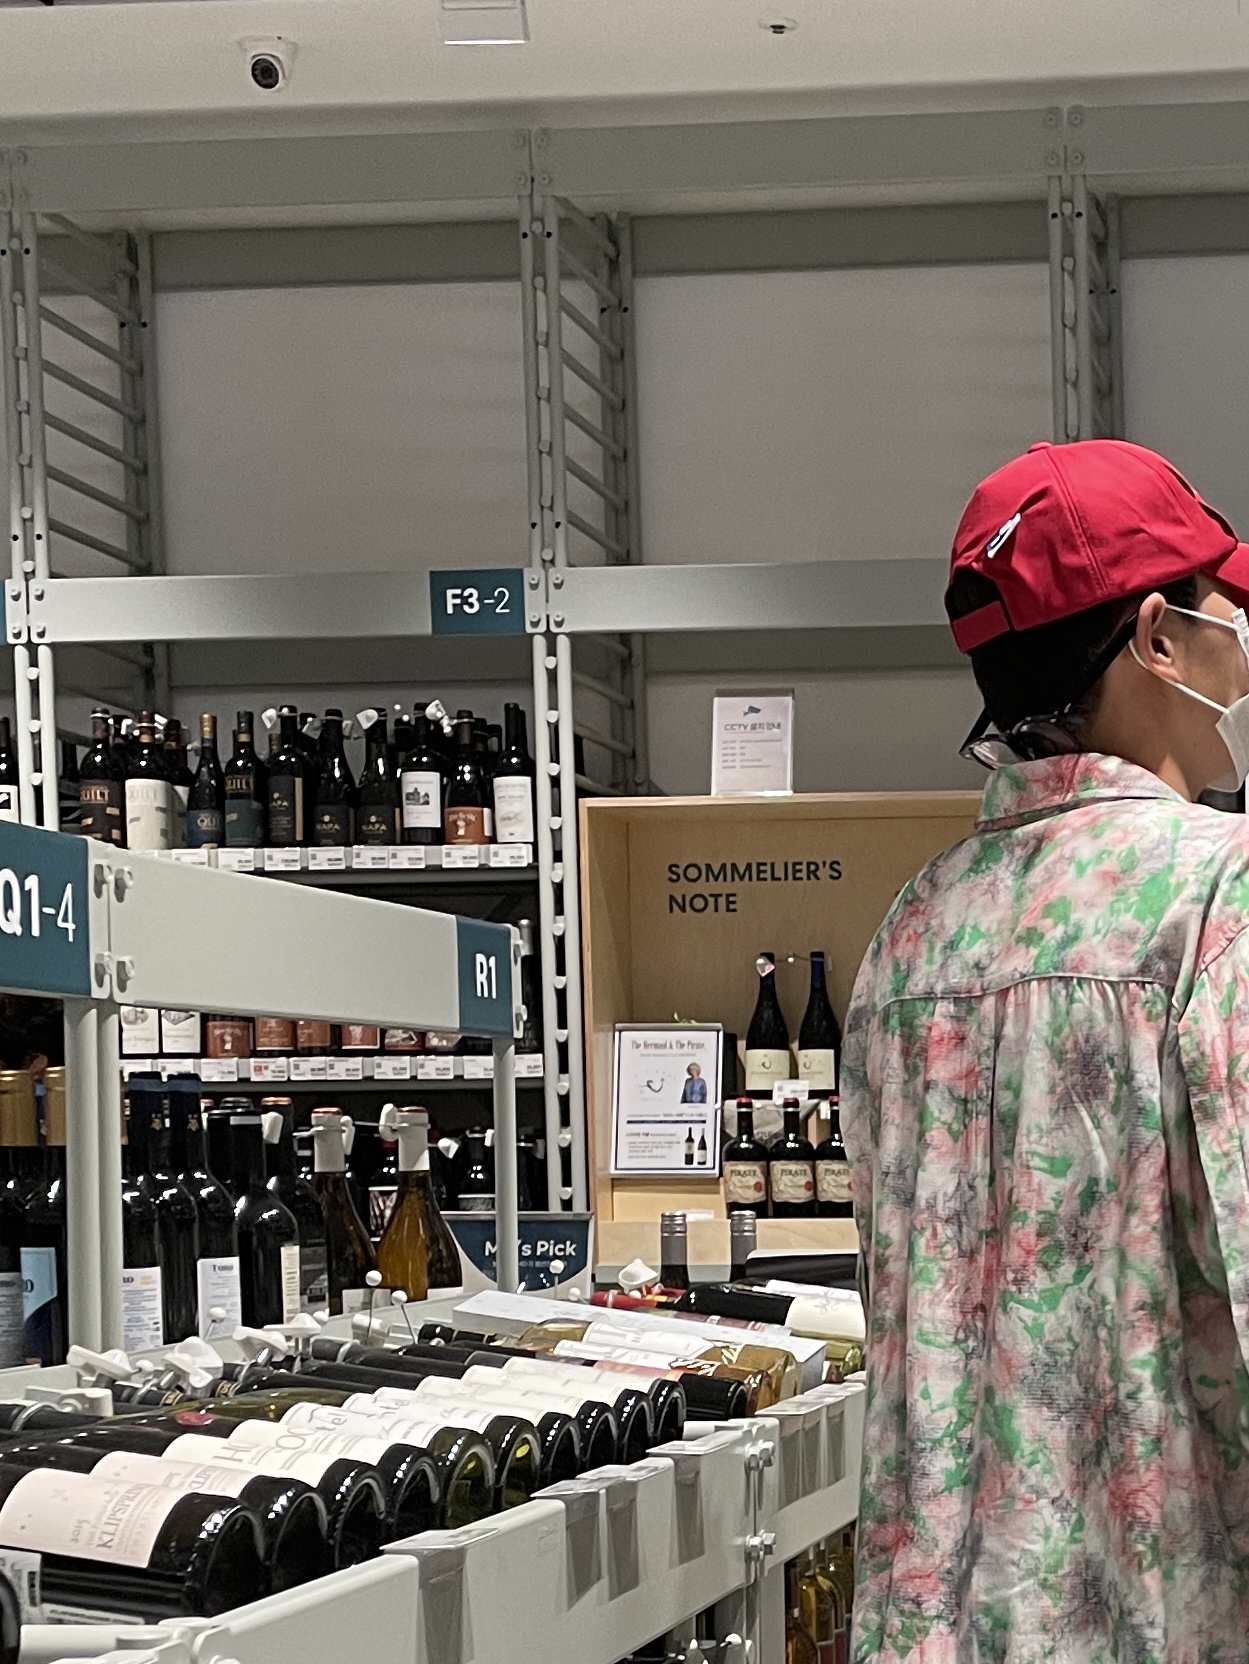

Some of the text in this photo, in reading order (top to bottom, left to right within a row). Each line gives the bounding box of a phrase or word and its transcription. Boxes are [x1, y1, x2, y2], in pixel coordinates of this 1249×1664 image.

[445, 587, 511, 615] F3-2
[723, 723, 749, 731] CCTV
[667, 860, 843, 883] SOMMELIER'S
[0, 868, 77, 943] Q1-4
[668, 892, 738, 914] NOTE
[475, 953, 497, 999] R1
[730, 1168, 757, 1178] PIRATE
[535, 1239, 578, 1257] Pick
